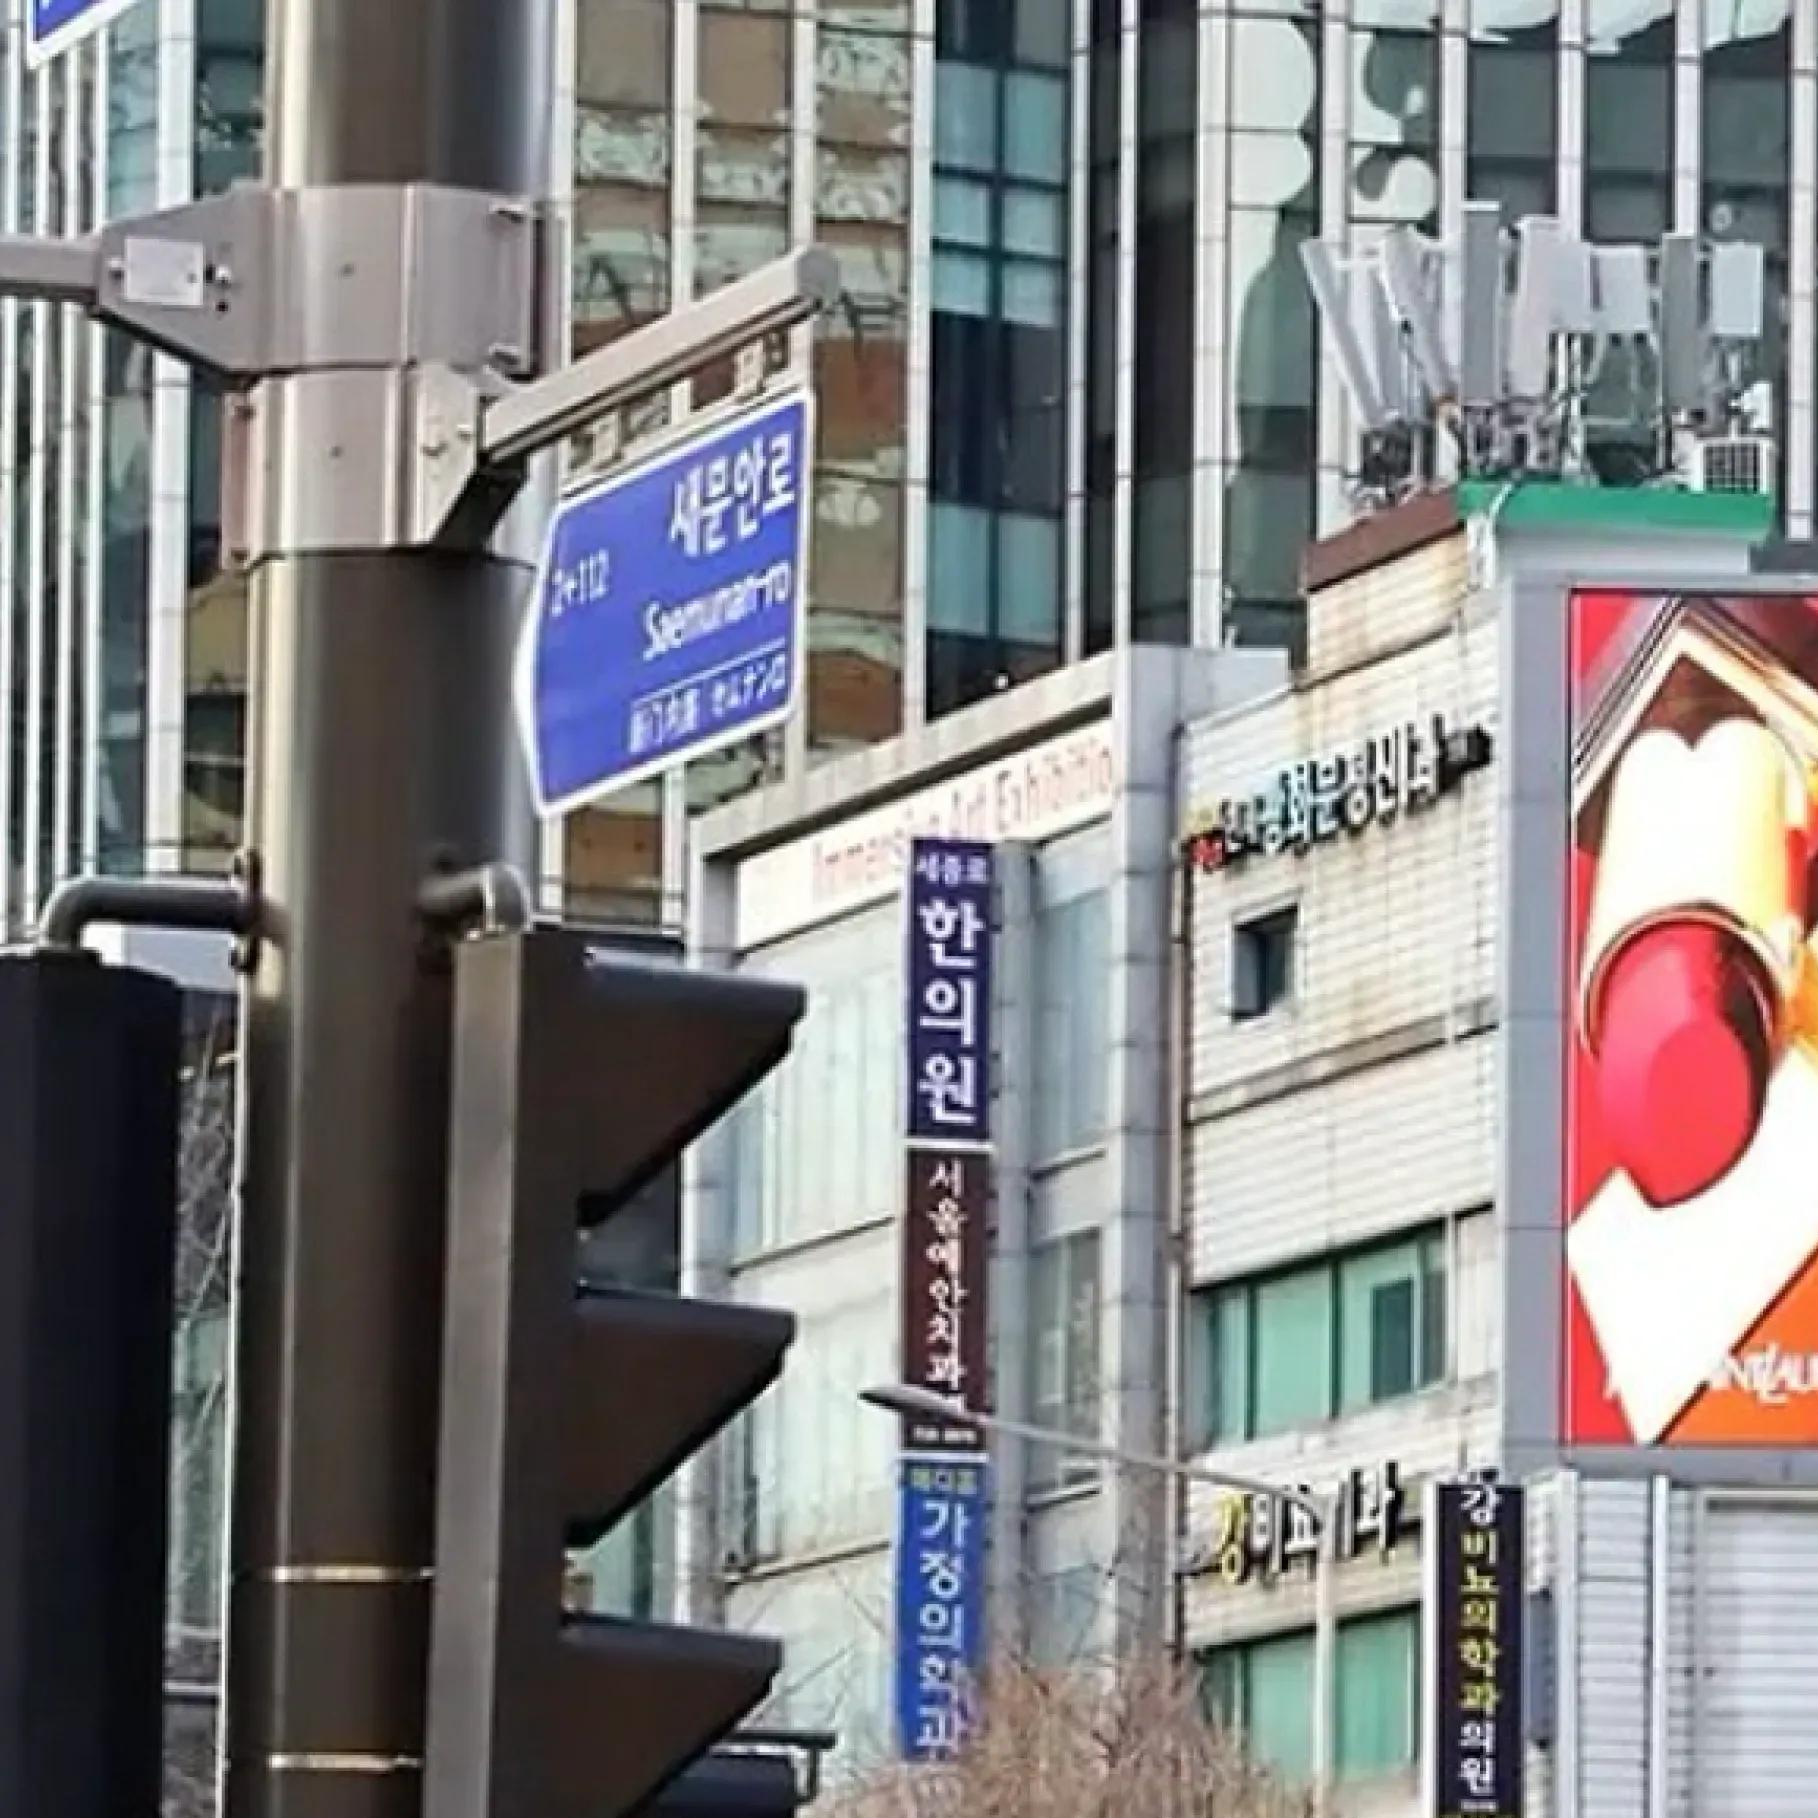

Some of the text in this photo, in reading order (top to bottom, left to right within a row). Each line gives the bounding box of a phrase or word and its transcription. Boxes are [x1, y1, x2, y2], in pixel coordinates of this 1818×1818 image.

[669, 431, 796, 557] 새문안로
[643, 560, 792, 662] Saemunan-ro
[916, 898, 985, 1126] 한의원
